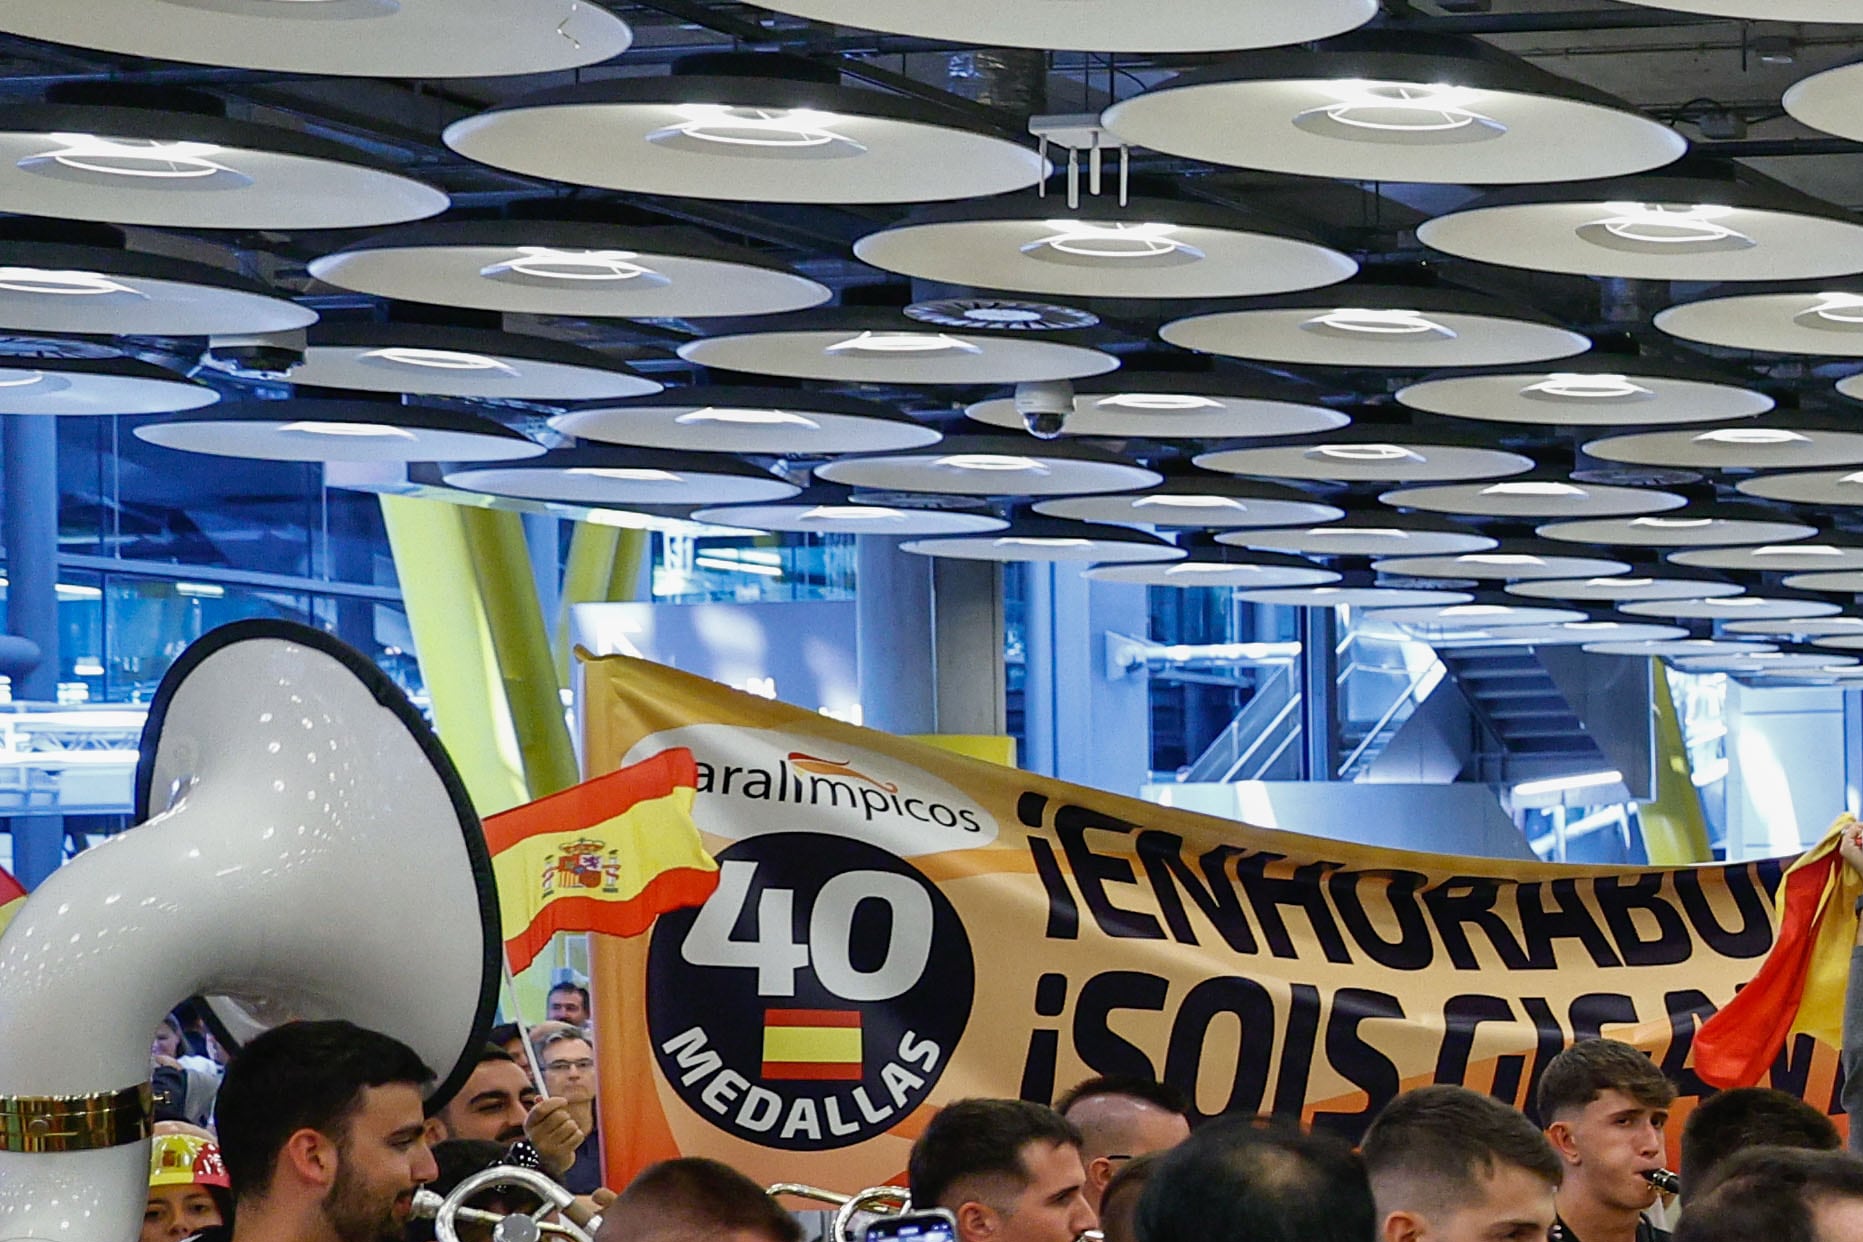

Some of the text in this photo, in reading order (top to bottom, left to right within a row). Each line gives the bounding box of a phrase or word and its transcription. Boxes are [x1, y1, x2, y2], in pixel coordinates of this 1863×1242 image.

[696, 759, 981, 833] aralimpicos
[681, 859, 935, 1002] 40
[661, 1025, 941, 1140] MEDALLAS
